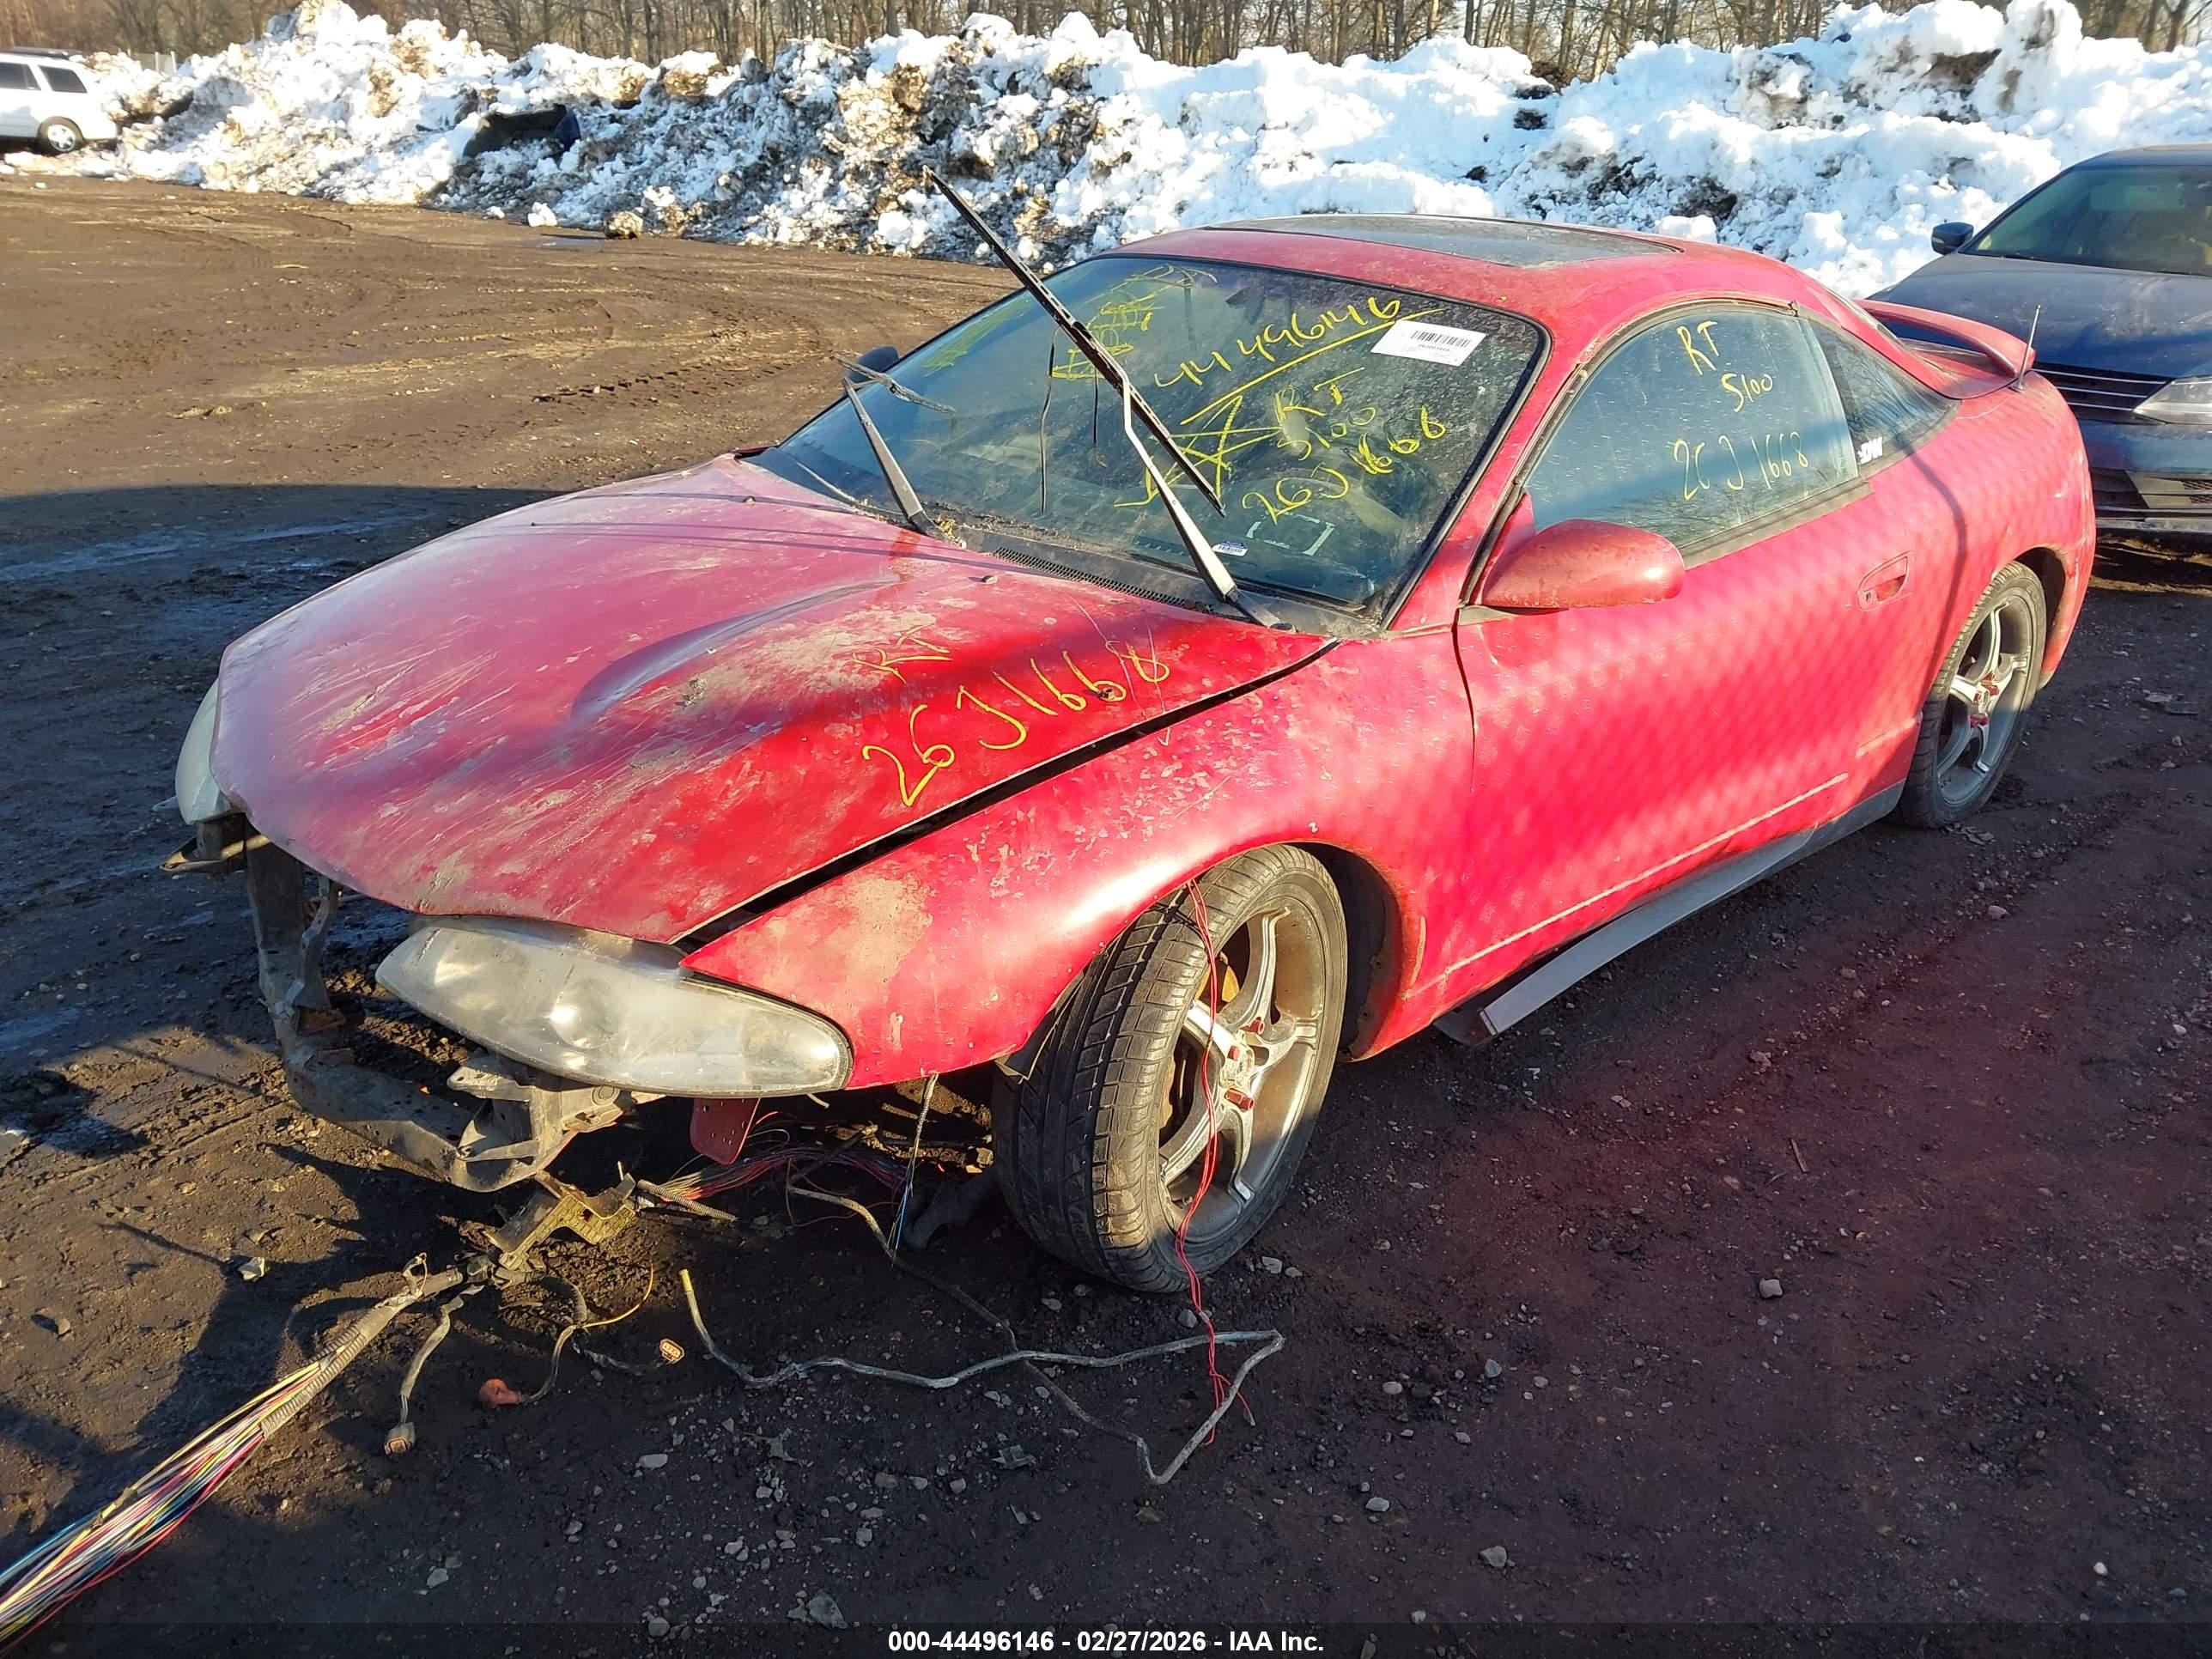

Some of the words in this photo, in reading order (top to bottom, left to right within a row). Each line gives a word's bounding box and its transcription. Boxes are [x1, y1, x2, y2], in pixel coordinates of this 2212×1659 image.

[1677, 320, 1718, 375] RT
[1273, 368, 1365, 421] RT
[852, 623, 953, 684] RT
